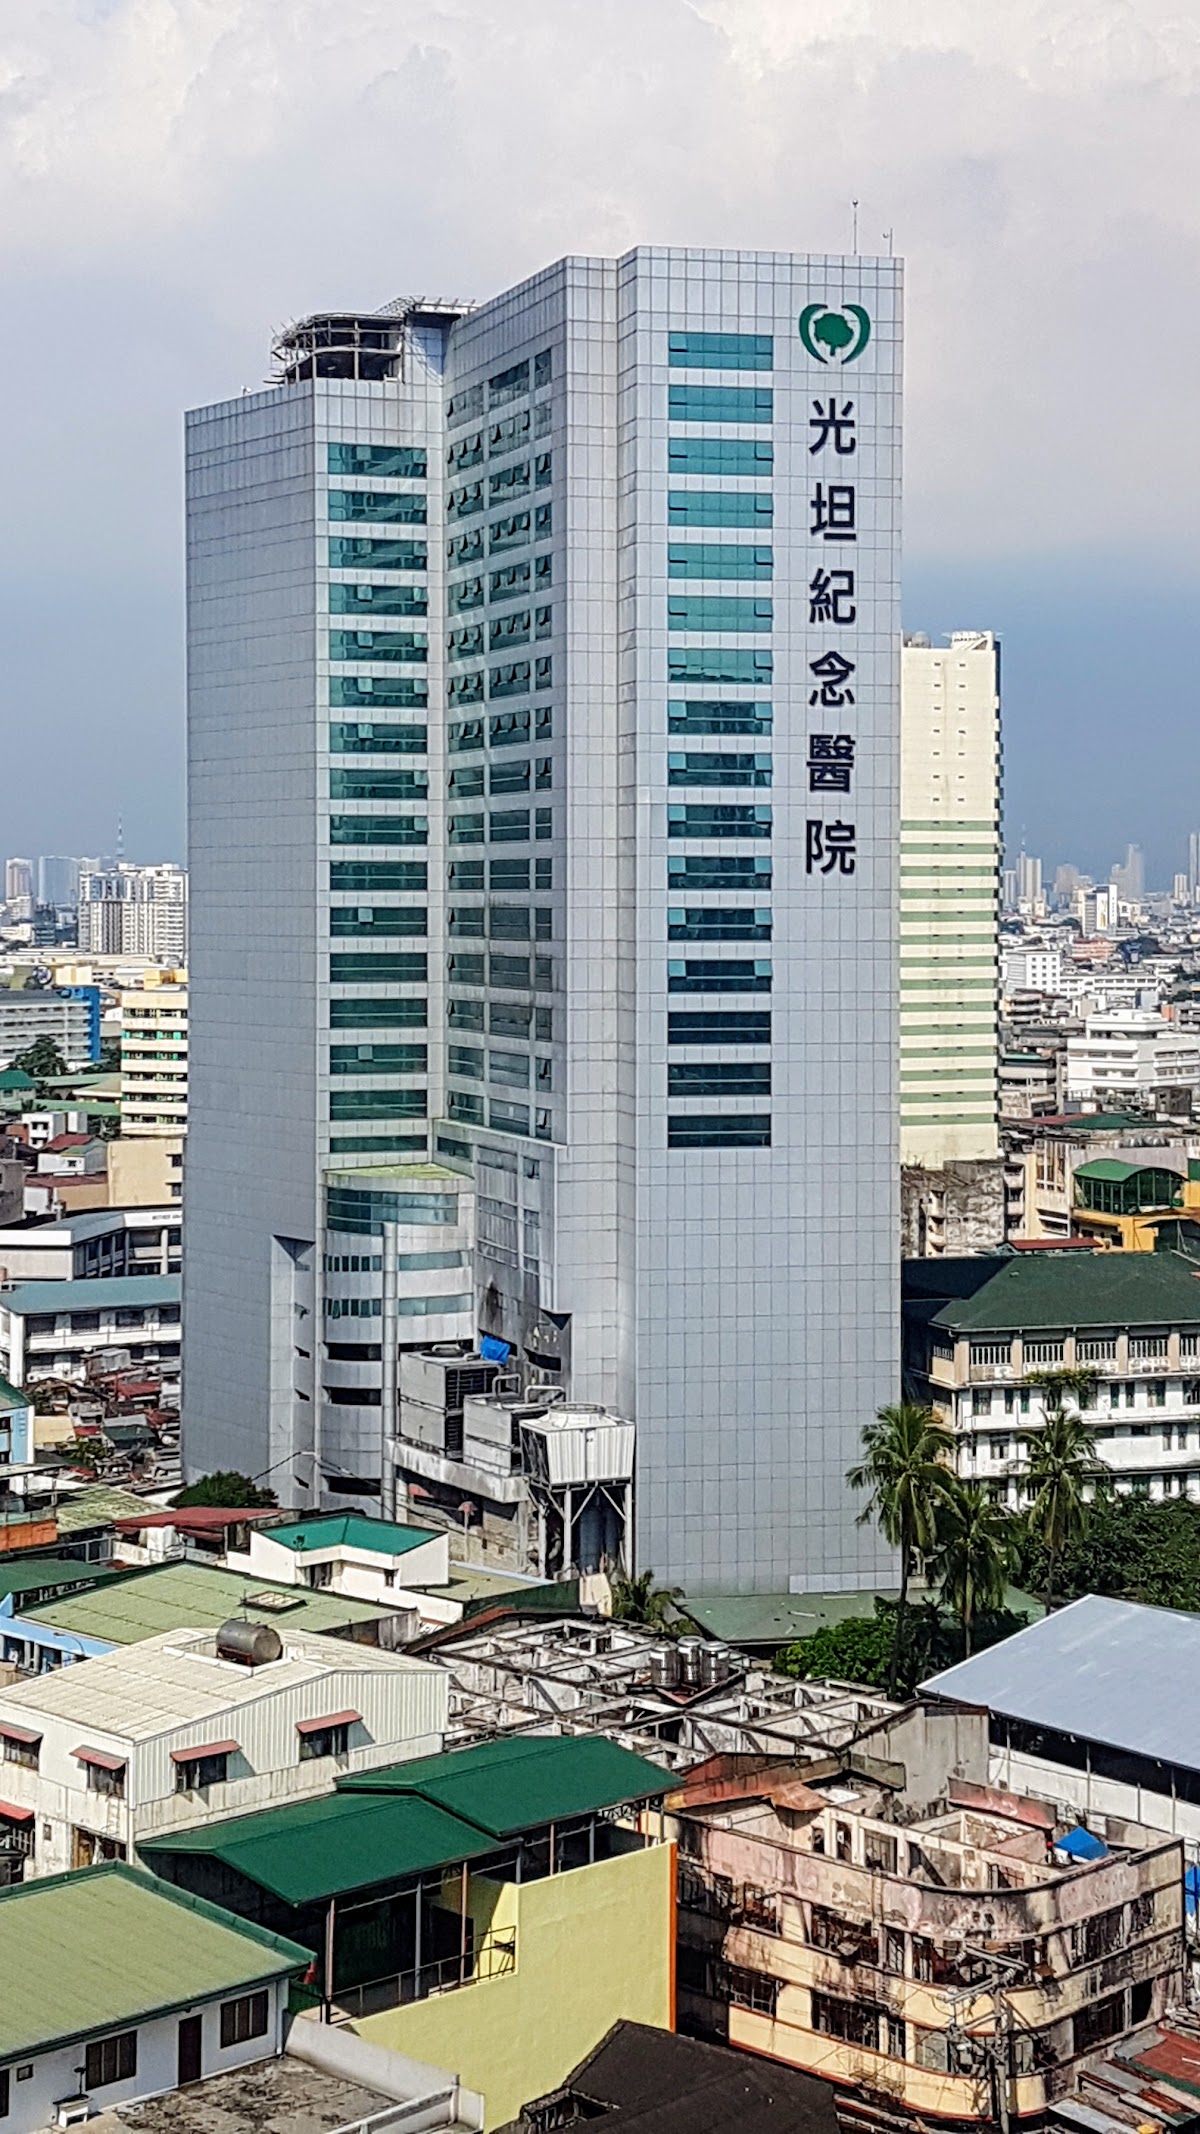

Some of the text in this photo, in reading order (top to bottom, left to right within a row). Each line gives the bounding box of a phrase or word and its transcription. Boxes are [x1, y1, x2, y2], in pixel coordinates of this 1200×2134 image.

[806, 397, 857, 877] 光坦紀念醫院
